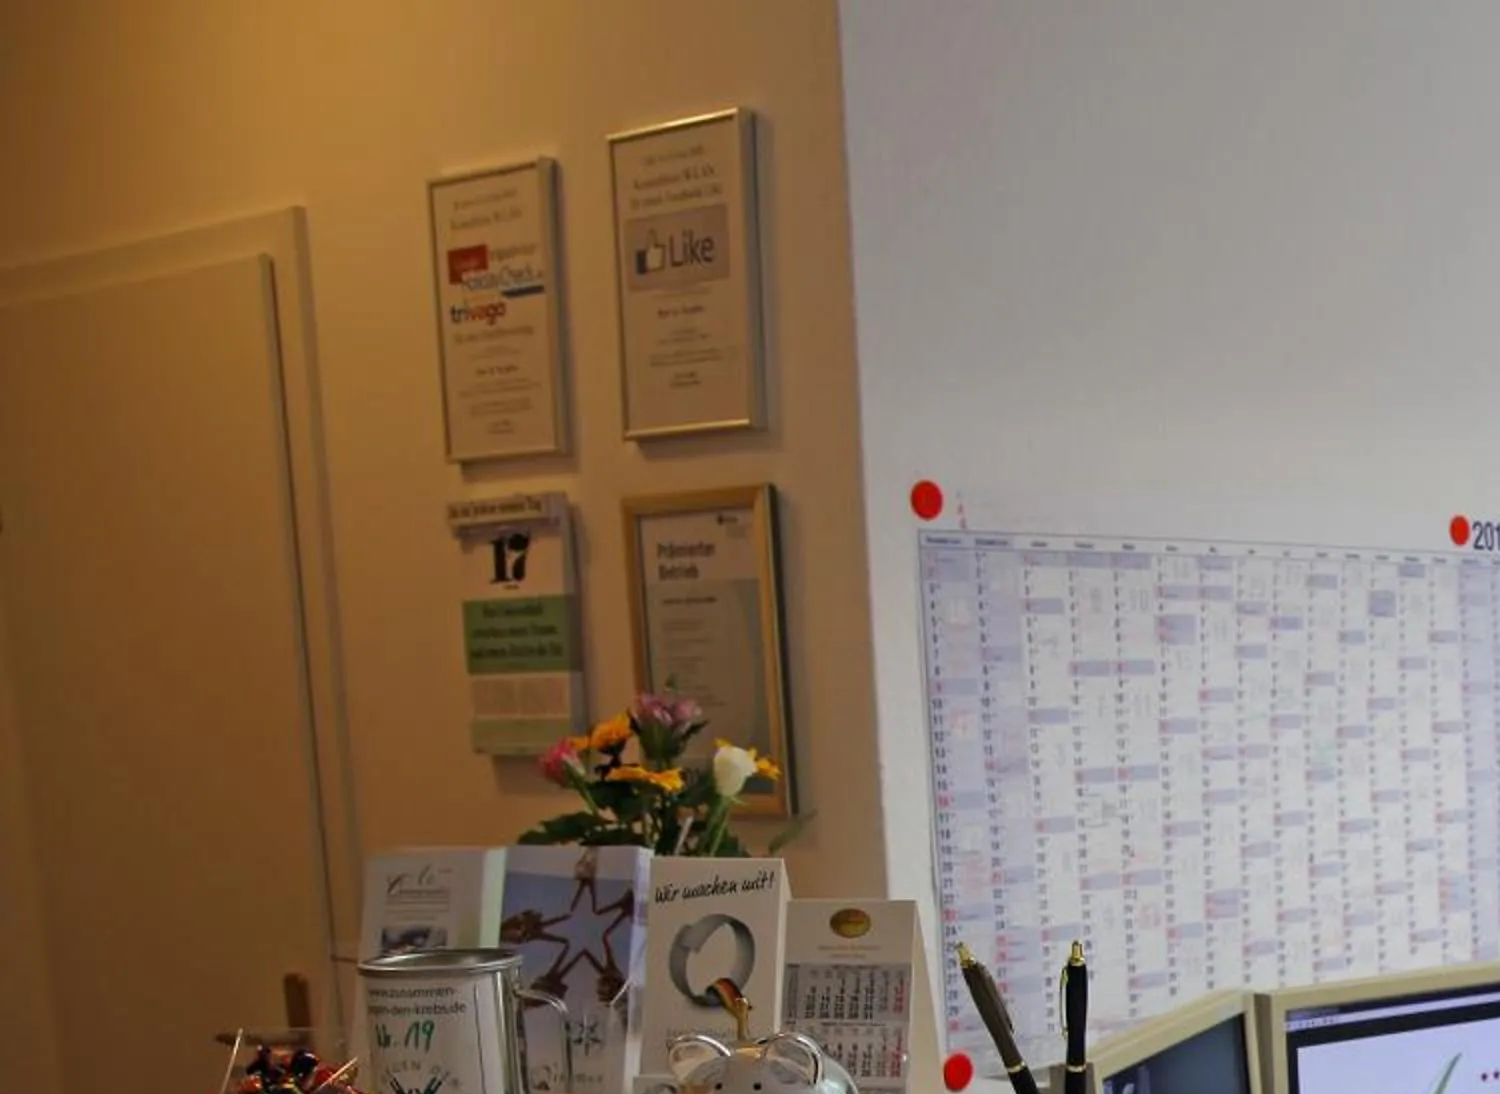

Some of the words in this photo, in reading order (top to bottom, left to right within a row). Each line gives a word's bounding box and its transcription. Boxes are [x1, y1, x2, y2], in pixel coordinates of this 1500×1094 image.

[669, 228, 715, 268] Like
[450, 302, 506, 326] trivago
[489, 530, 531, 585] 17
[404, 1020, 435, 1054] 19
